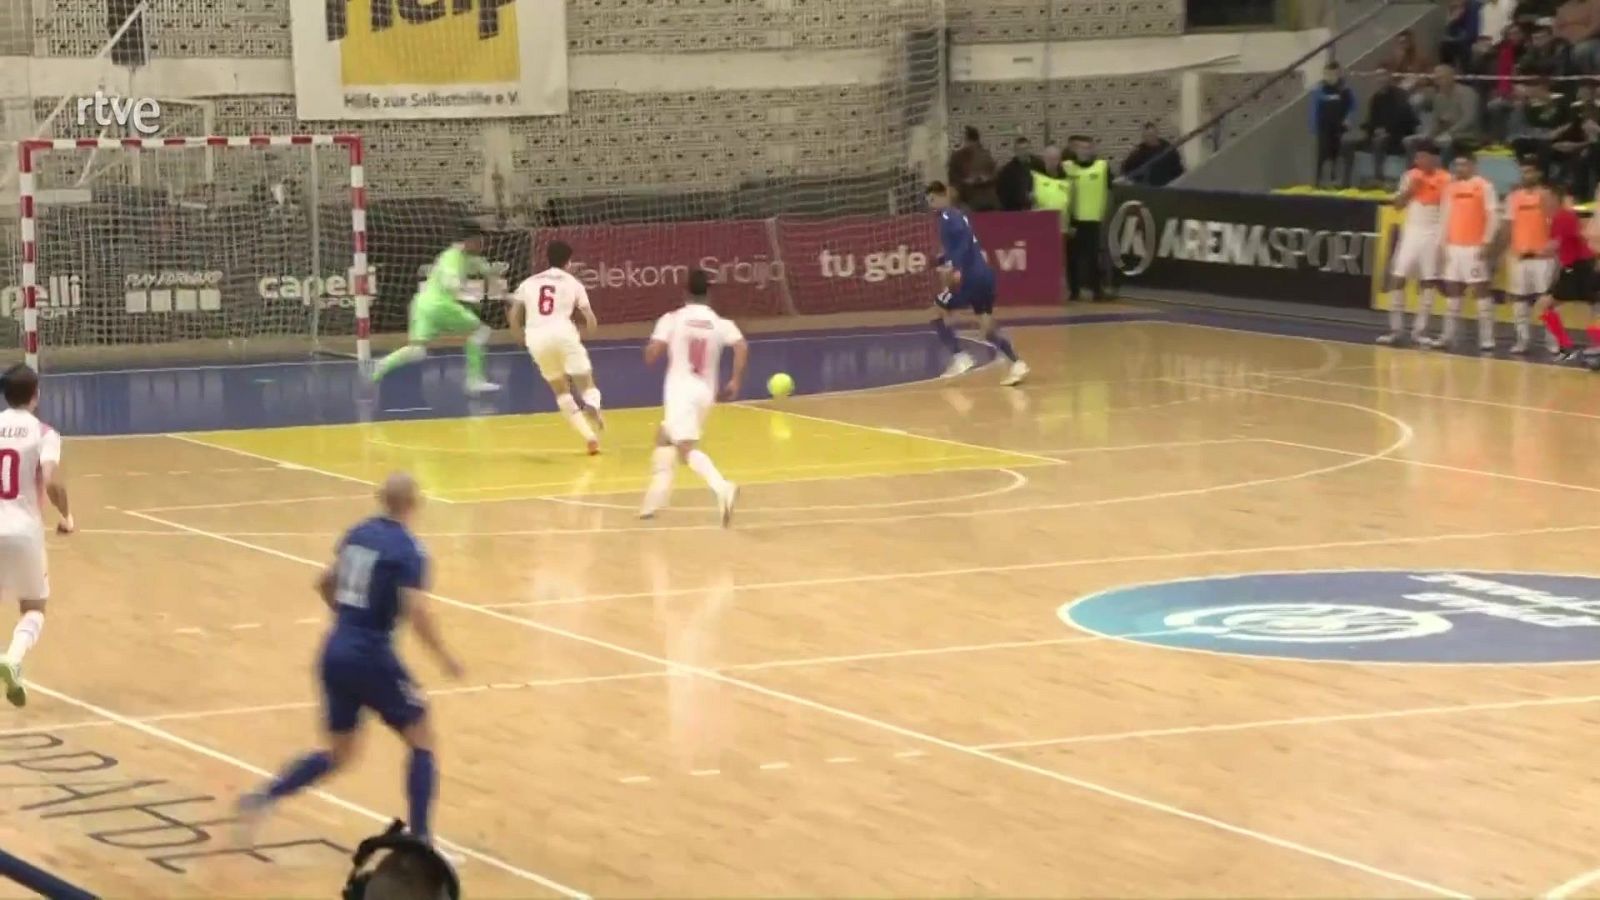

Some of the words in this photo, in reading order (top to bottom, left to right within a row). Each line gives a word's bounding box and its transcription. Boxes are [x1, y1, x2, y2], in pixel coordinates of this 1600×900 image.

[819, 249, 856, 278] tu
[864, 245, 927, 282] gde
[994, 240, 1027, 271] vi
[538, 284, 556, 316] 6
